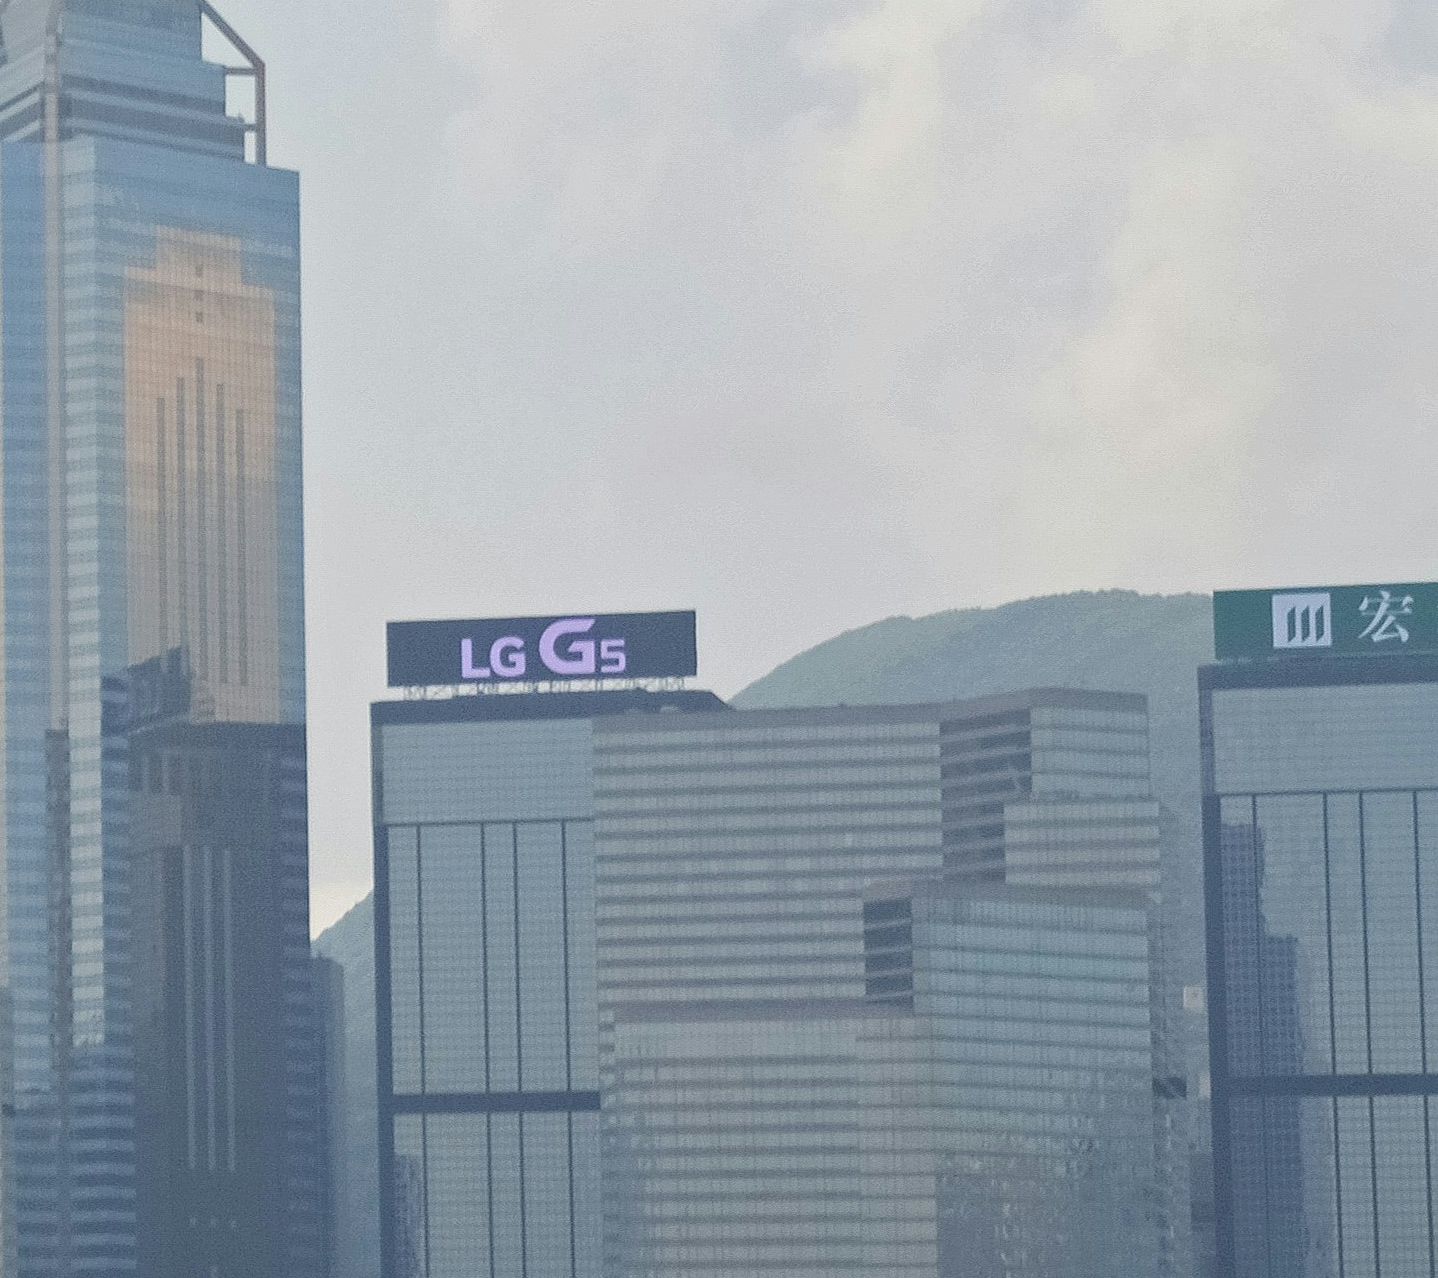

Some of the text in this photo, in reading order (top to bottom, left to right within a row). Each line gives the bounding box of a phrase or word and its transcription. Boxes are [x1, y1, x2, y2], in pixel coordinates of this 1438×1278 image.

[1358, 590, 1414, 643] 宏
[460, 617, 627, 679] LG G5
